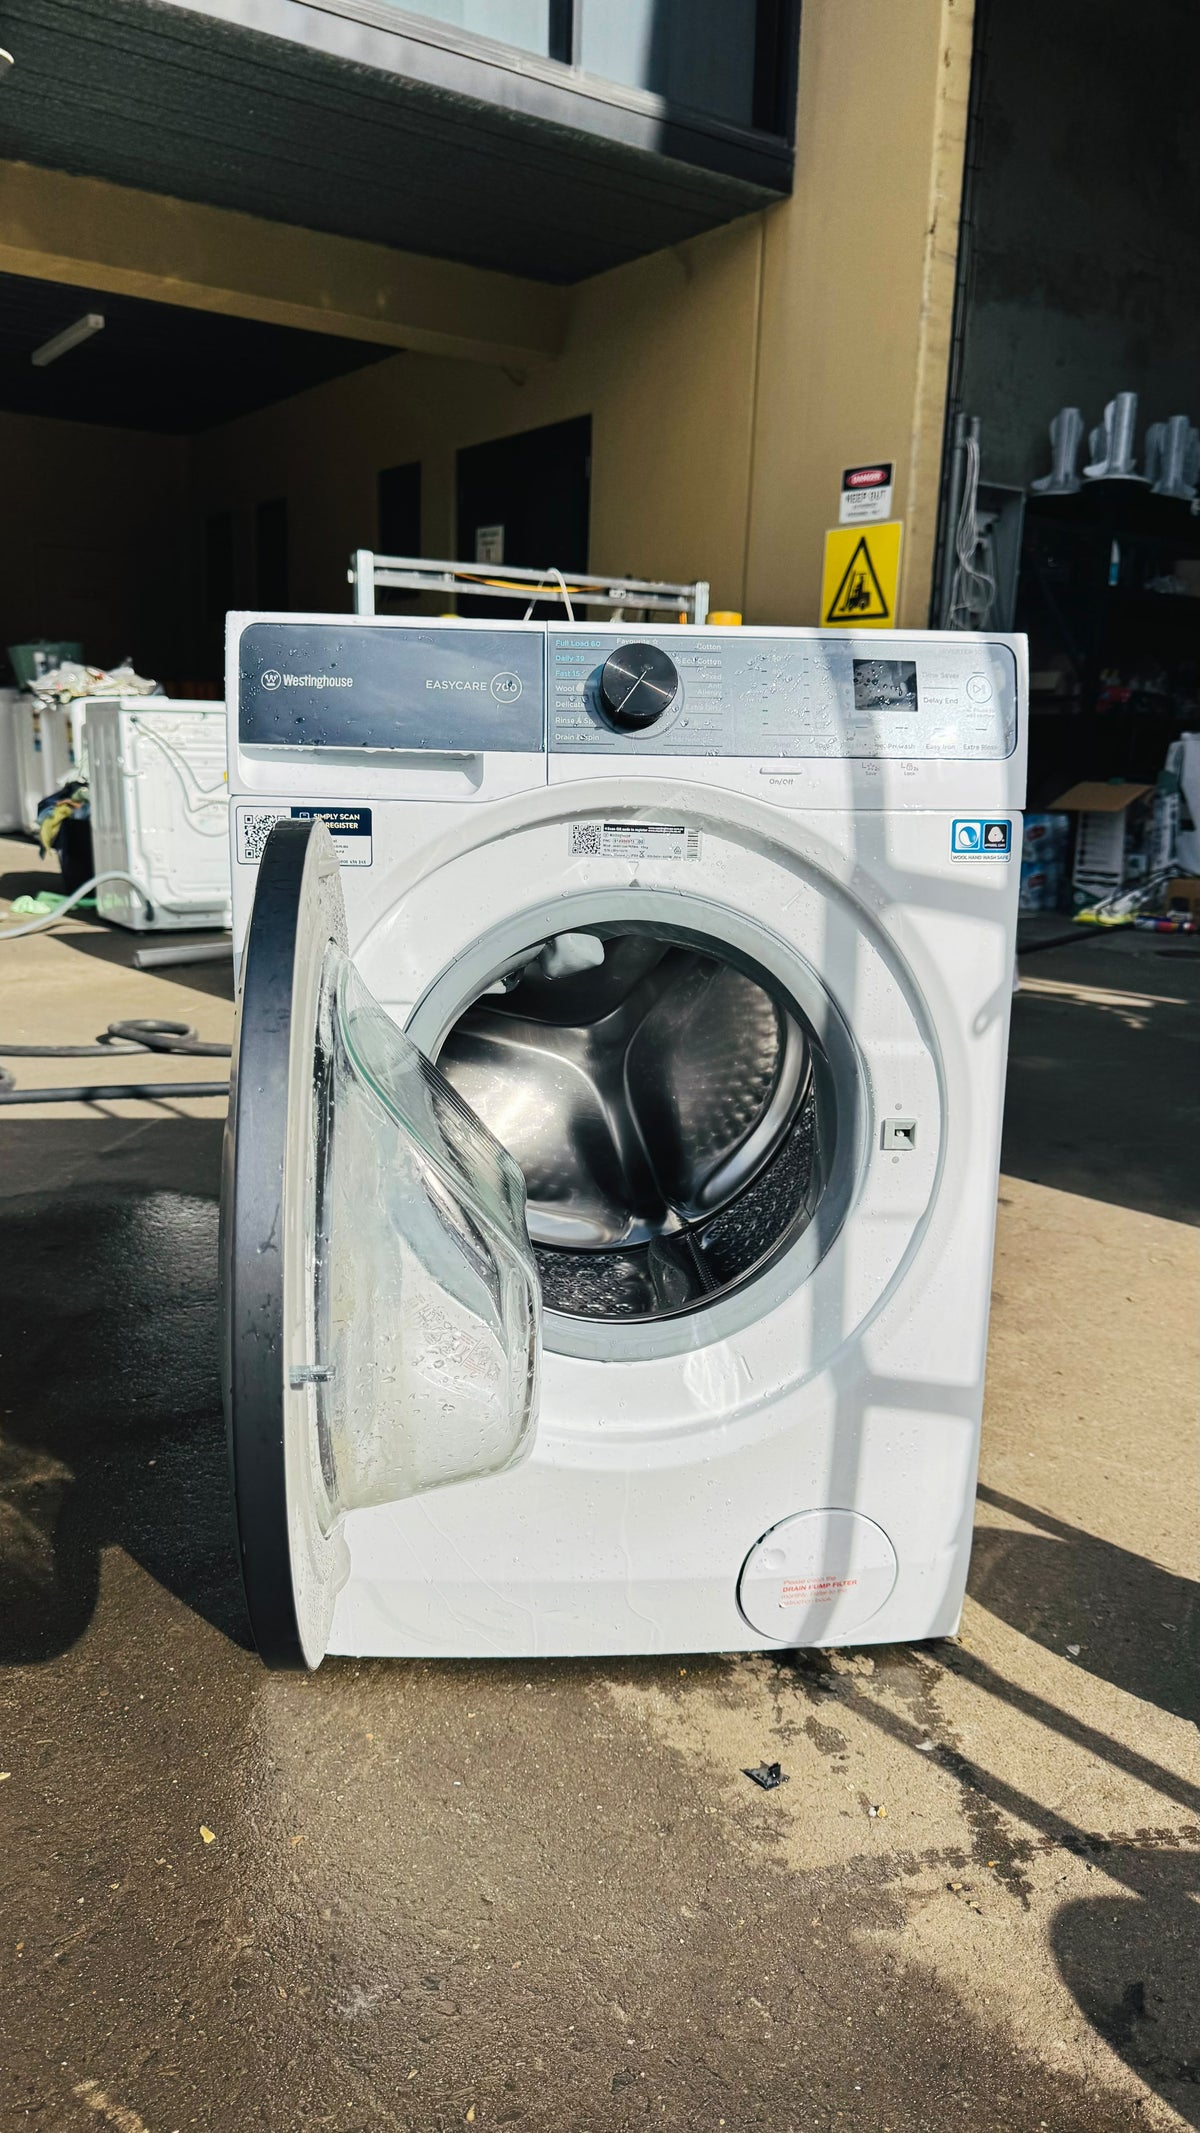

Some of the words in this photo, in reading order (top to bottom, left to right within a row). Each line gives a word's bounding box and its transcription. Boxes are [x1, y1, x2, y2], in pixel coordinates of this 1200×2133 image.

[847, 492, 867, 503] KEEP
[870, 490, 886, 501] OUT
[555, 639, 569, 647] Full
[283, 674, 353, 690] Westinghouse
[425, 679, 487, 691] EASYCARE
[495, 682, 517, 693] 700
[555, 684, 575, 692] Wool
[923, 697, 943, 705] Delay
[555, 716, 575, 724] Rinse
[555, 733, 575, 741] Drain
[325, 821, 359, 829] REGISTER
[782, 1584, 807, 1592] DRAIN
[808, 1582, 831, 1590] PUMP
[832, 1579, 858, 1588] FILTER
